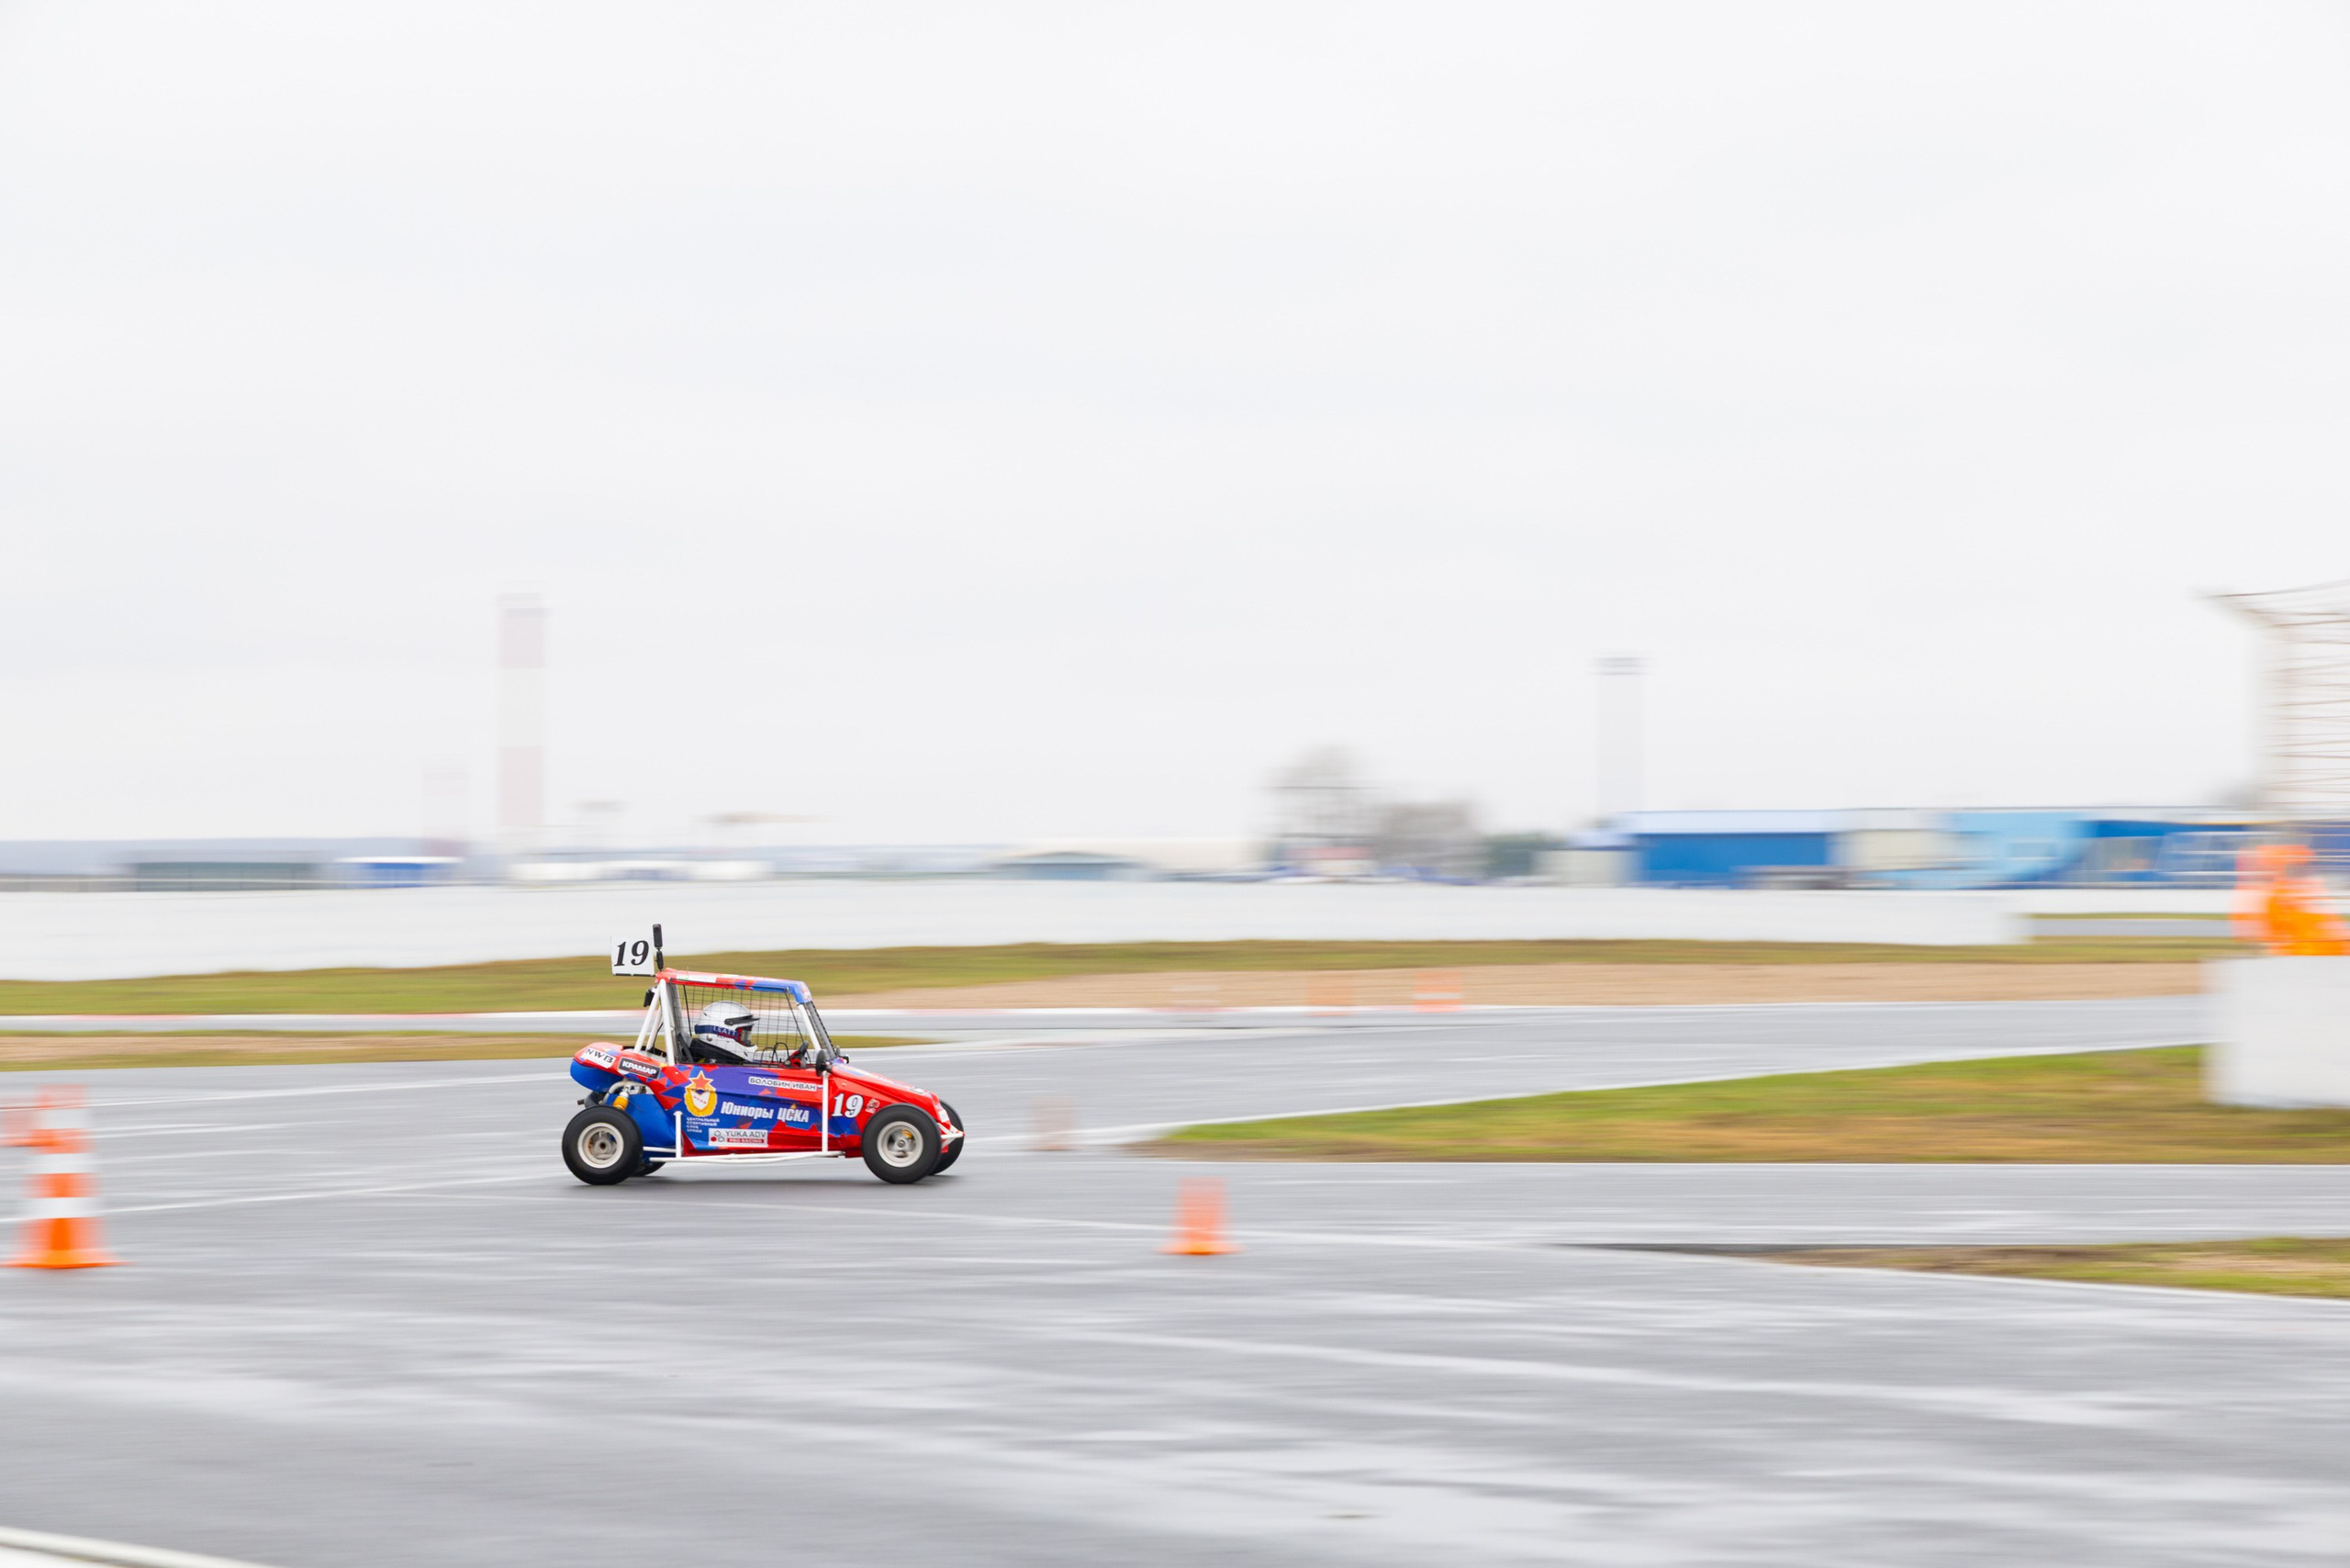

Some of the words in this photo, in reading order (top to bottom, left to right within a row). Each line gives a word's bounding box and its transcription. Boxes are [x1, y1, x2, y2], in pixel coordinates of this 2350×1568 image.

[613, 940, 649, 967] 19
[621, 1060, 657, 1075] КРАМАР
[720, 1102, 774, 1119] Юниоры
[777, 1107, 810, 1123] ЦСКА
[831, 1092, 864, 1118] 19
